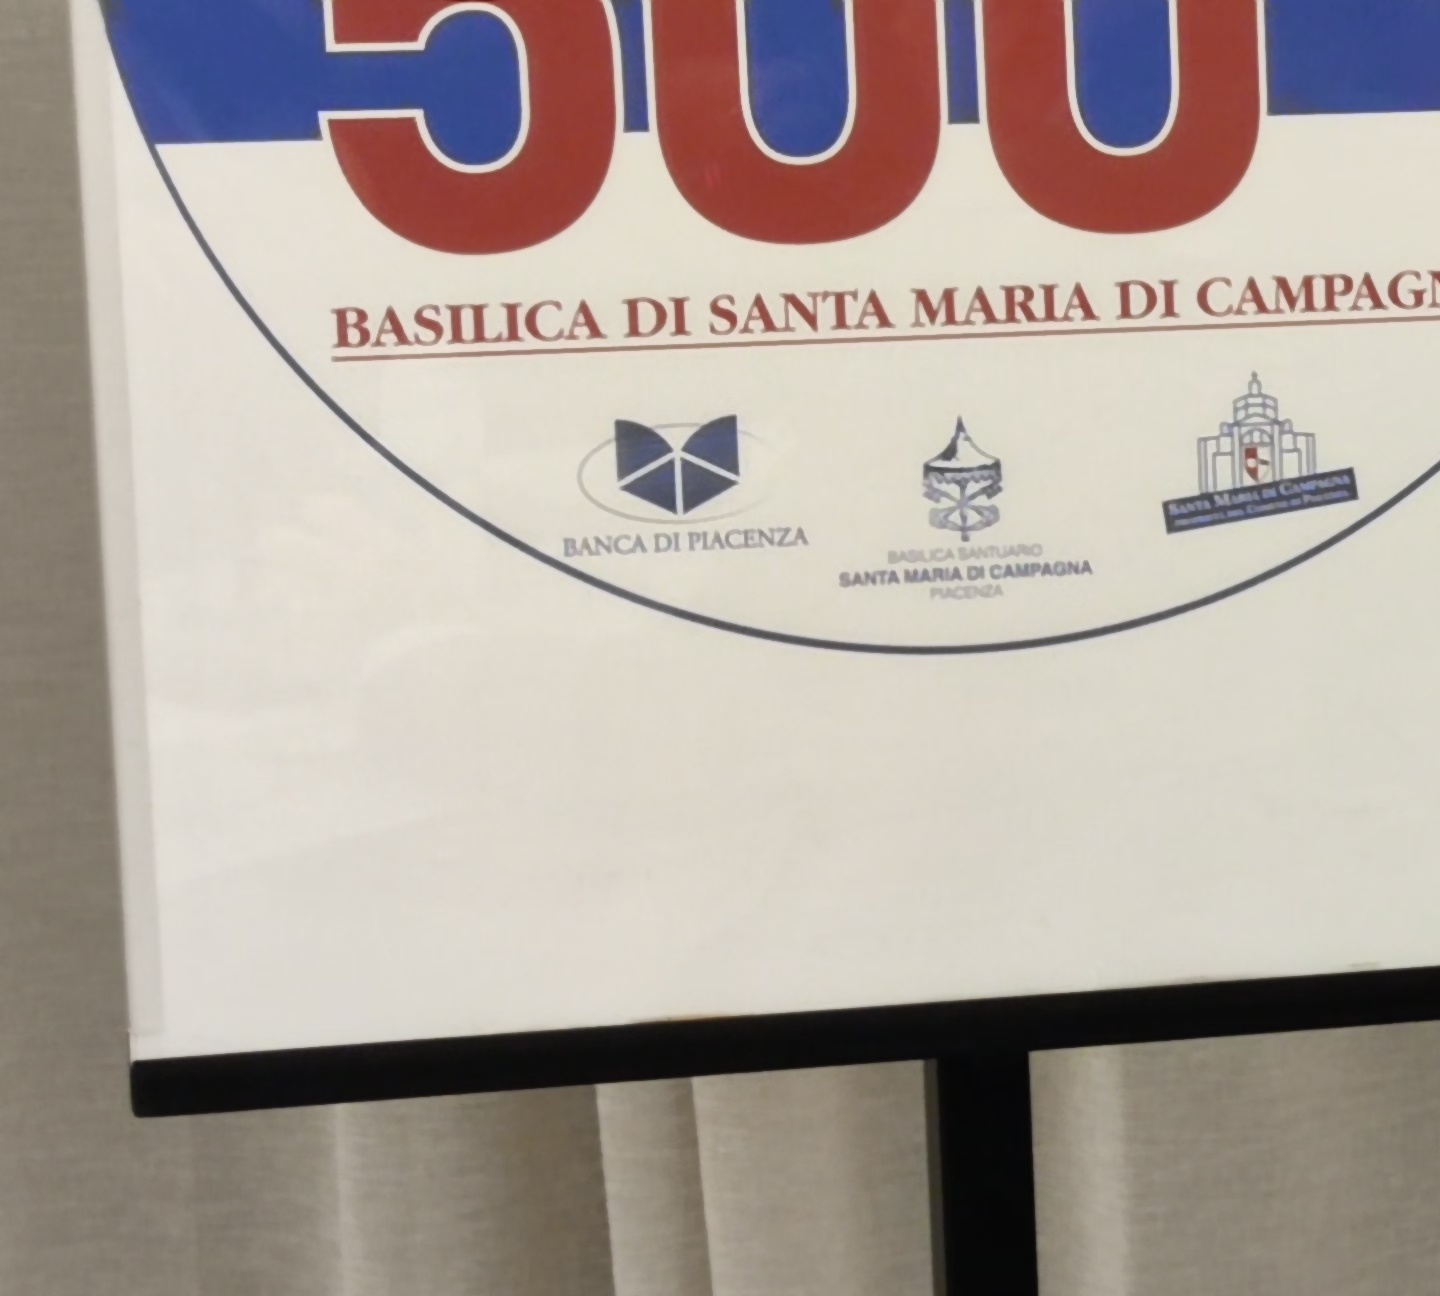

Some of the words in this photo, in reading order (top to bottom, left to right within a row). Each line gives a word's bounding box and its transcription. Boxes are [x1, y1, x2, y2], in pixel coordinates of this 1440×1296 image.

[318, 0, 1263, 255] 500
[331, 299, 608, 349] BASILICA
[622, 296, 692, 338] DI
[708, 287, 896, 336] SANTA
[911, 281, 1100, 329] MARIA
[1115, 279, 1180, 321] DI
[562, 533, 648, 558] BANCA
[653, 532, 681, 554] DI
[687, 526, 810, 551] PIACENZA
[887, 547, 955, 565] BASILICA
[958, 542, 1044, 561] SANTUARIO
[838, 569, 901, 589] SANTA
[903, 565, 963, 584] MARIA
[966, 564, 985, 581] DI
[989, 559, 1094, 581] CAMPAGNA
[929, 583, 1004, 600] PIACENZA
